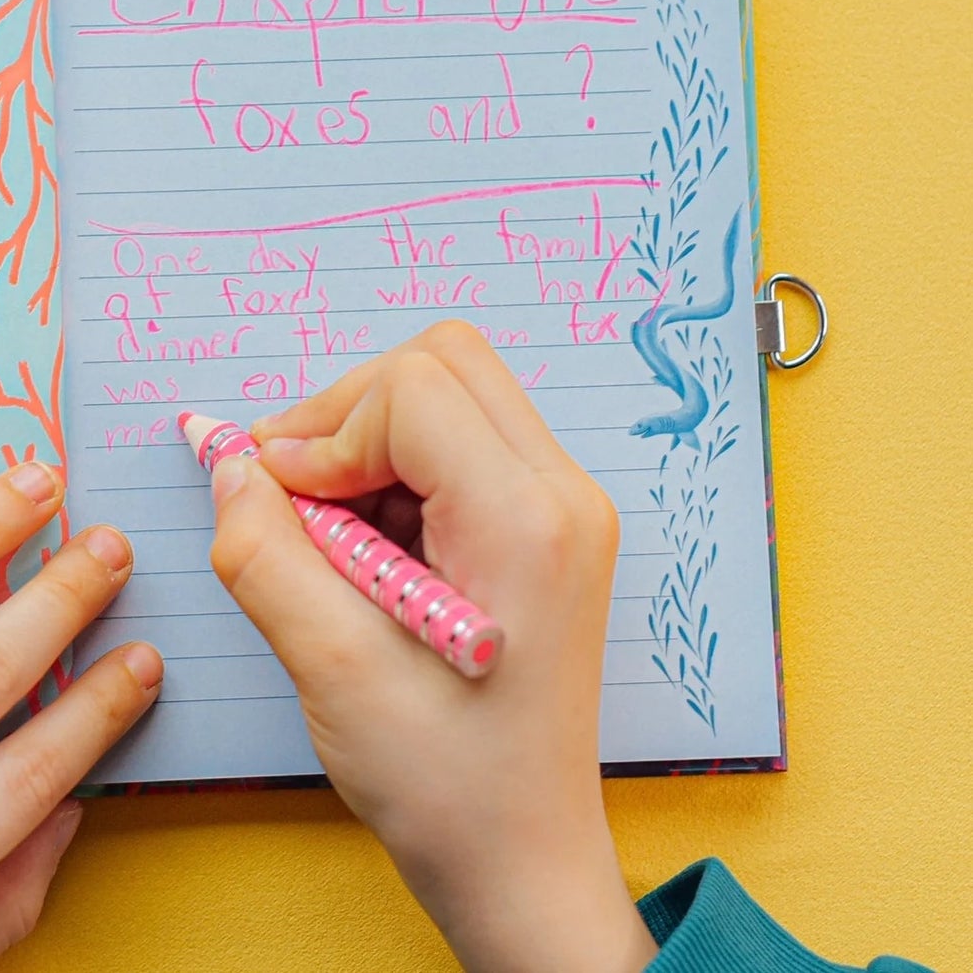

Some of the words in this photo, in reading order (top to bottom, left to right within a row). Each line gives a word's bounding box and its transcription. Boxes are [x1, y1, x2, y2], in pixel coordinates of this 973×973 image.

[180, 58, 371, 153] foxes
[428, 53, 521, 144] and
[564, 43, 596, 131] ?
[113, 236, 211, 277] One
[248, 234, 320, 299] day
[379, 210, 457, 268] the
[496, 191, 632, 300] family
[218, 277, 331, 316] foxes
[376, 265, 488, 308] where
[116, 317, 256, 365] dinner
[291, 310, 372, 361] the
[567, 302, 620, 346] fox
[103, 377, 180, 405] was
